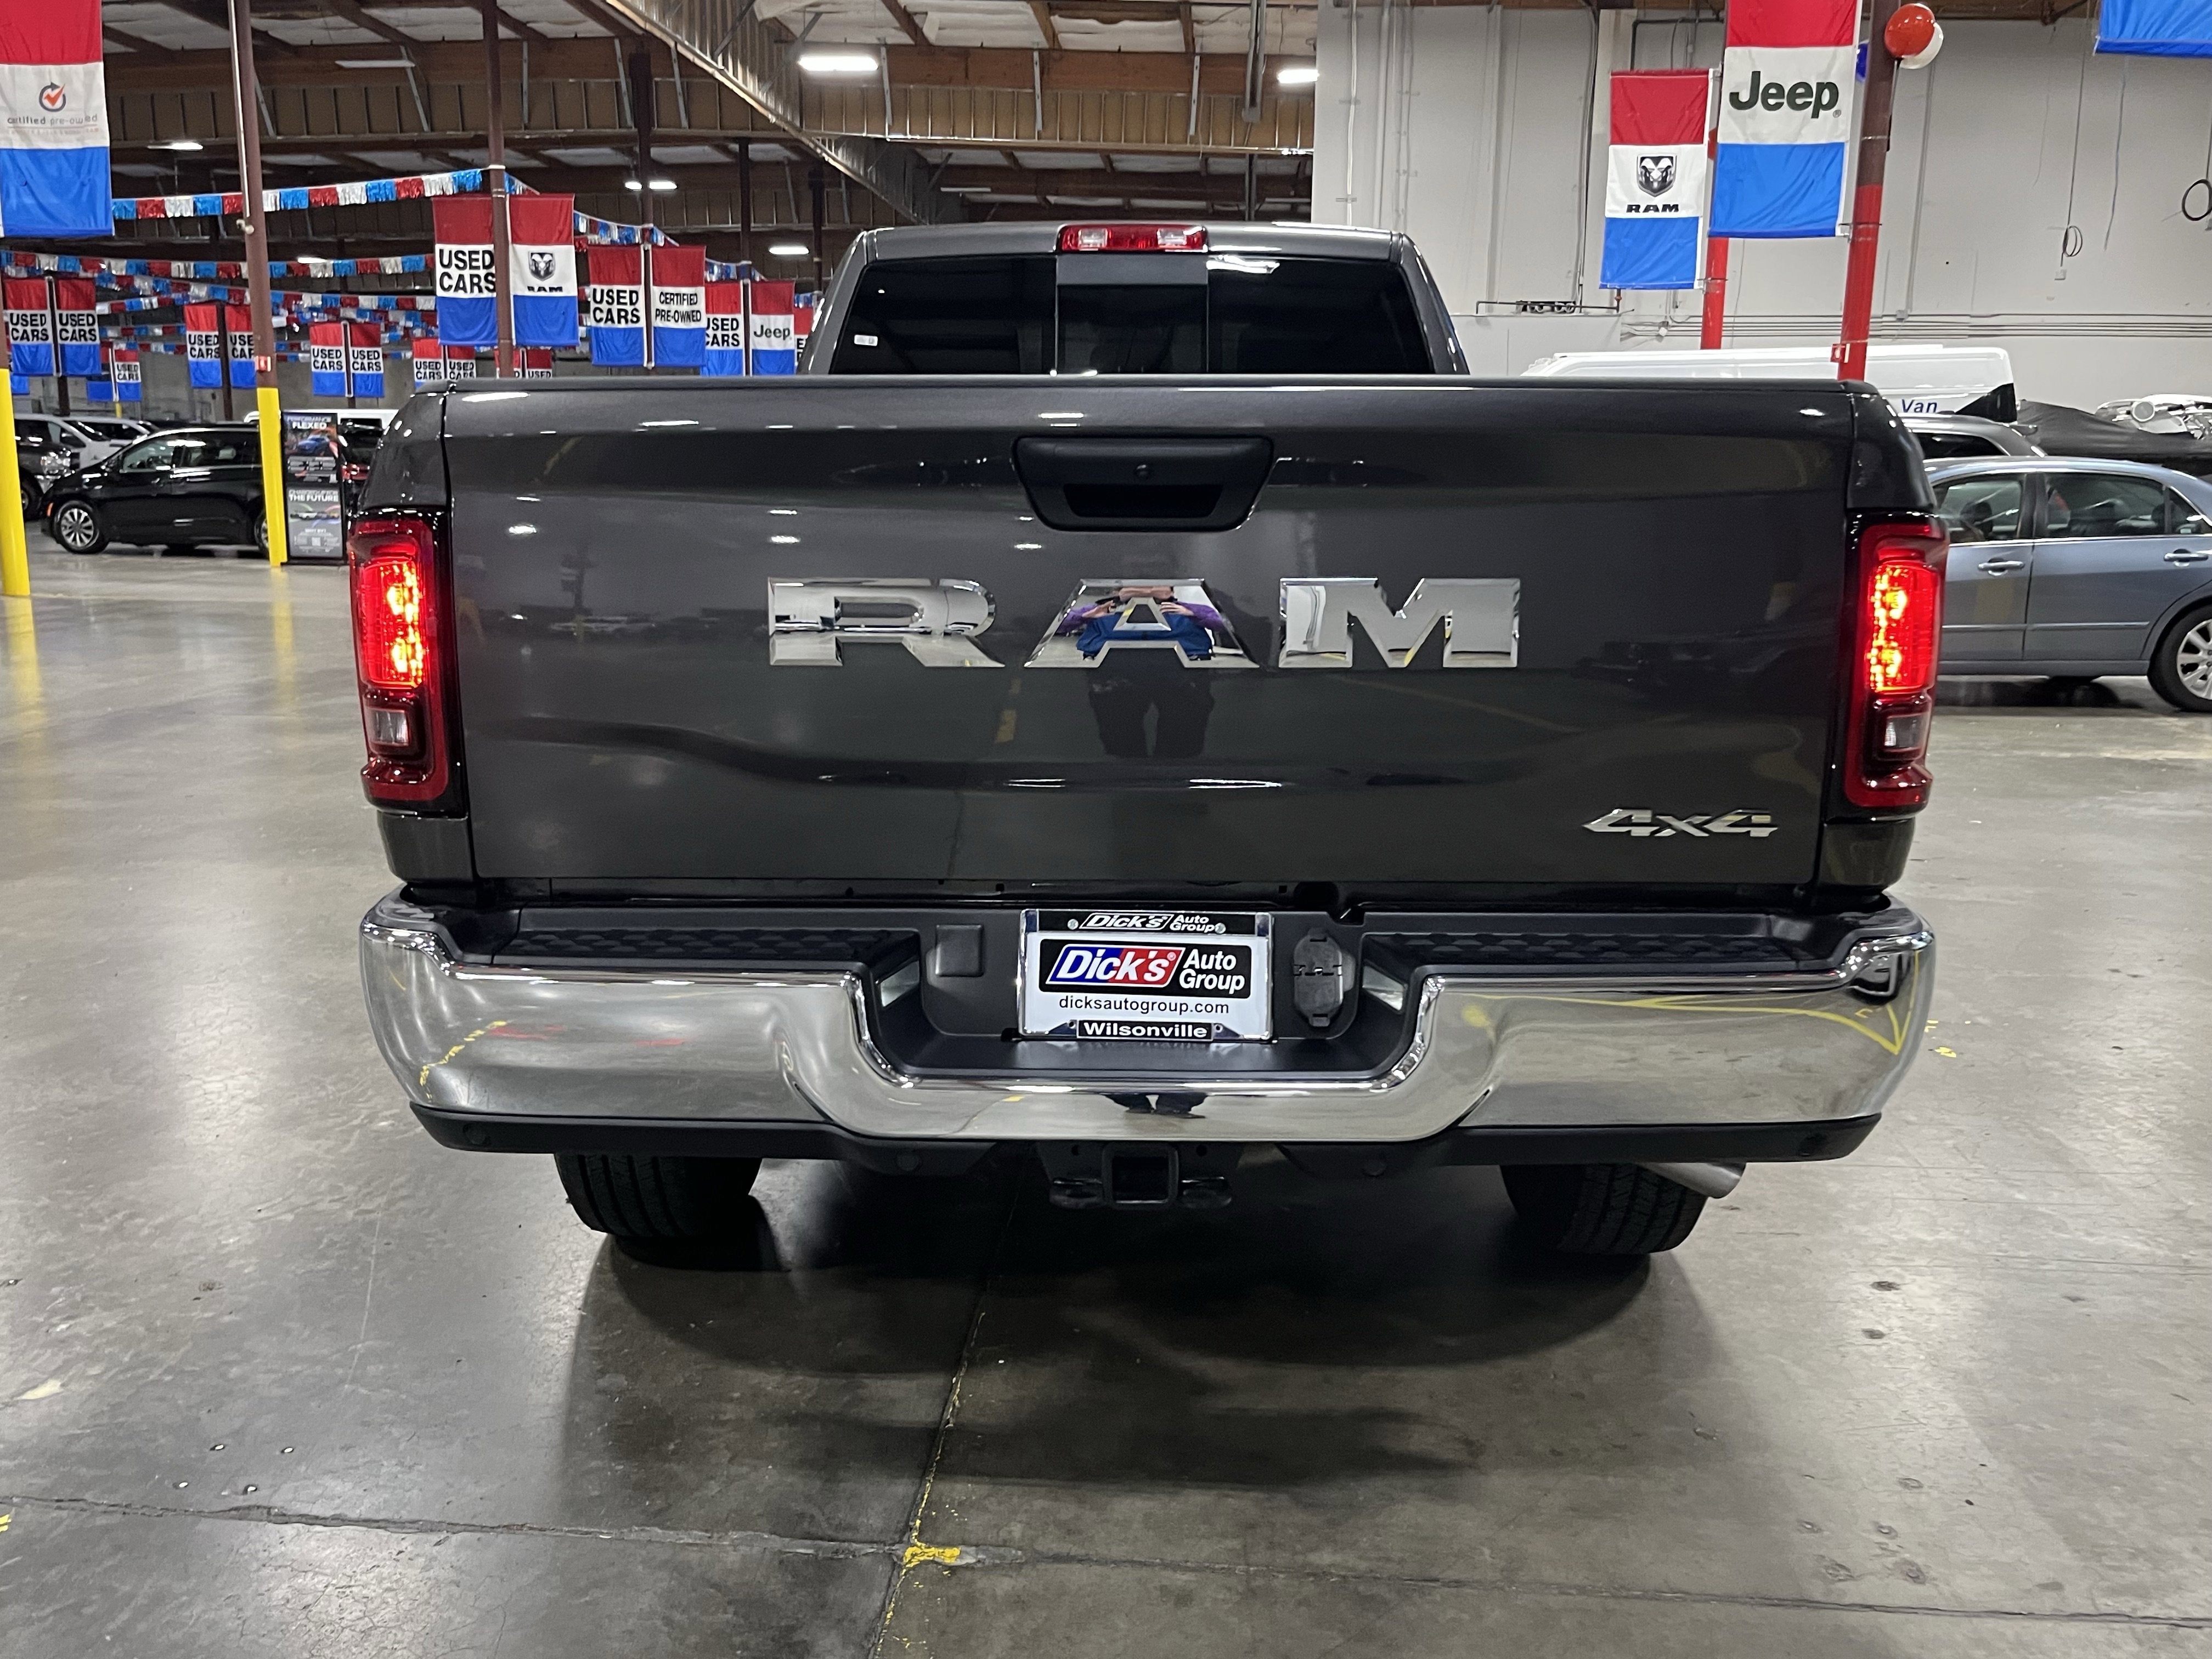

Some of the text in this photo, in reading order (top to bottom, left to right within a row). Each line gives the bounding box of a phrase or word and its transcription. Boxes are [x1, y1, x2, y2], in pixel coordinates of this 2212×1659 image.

[1729, 71, 1839, 119] Jeep
[50, 114, 97, 126] pre-owed
[1626, 204, 1679, 212] RAM
[439, 249, 494, 270] USED
[439, 272, 496, 294] CARS
[592, 289, 639, 306] USED
[659, 291, 698, 306] CERTIFIED
[10, 313, 46, 327] USED
[59, 313, 95, 326] USED
[593, 307, 640, 325] CARS
[655, 308, 701, 323] PRE-OWNED
[11, 328, 49, 341] CARS
[59, 328, 97, 341] CARS
[754, 325, 790, 341] Jeep
[188, 334, 219, 346] USED
[230, 335, 254, 346] USE
[189, 347, 219, 358] CARS
[313, 348, 342, 359] USED
[352, 350, 380, 360] USED
[313, 360, 343, 370] CARS
[352, 361, 381, 371] CARS
[415, 361, 441, 370] USED
[449, 361, 474, 370] USED
[416, 371, 442, 380] CARS
[1902, 399, 1937, 413] Van
[768, 578, 1522, 668] RAM
[1582, 809, 1778, 837] 4x4
[1086, 915, 1164, 928] Dick's
[1173, 915, 1209, 923] Auto
[1170, 922, 1215, 933] Group
[1056, 949, 1170, 982] Dick's
[1184, 949, 1237, 970] Auto
[1180, 969, 1245, 994] Group
[1059, 996, 1229, 1015] dicksautogroup.com
[1084, 1023, 1207, 1038] Wilsonville
